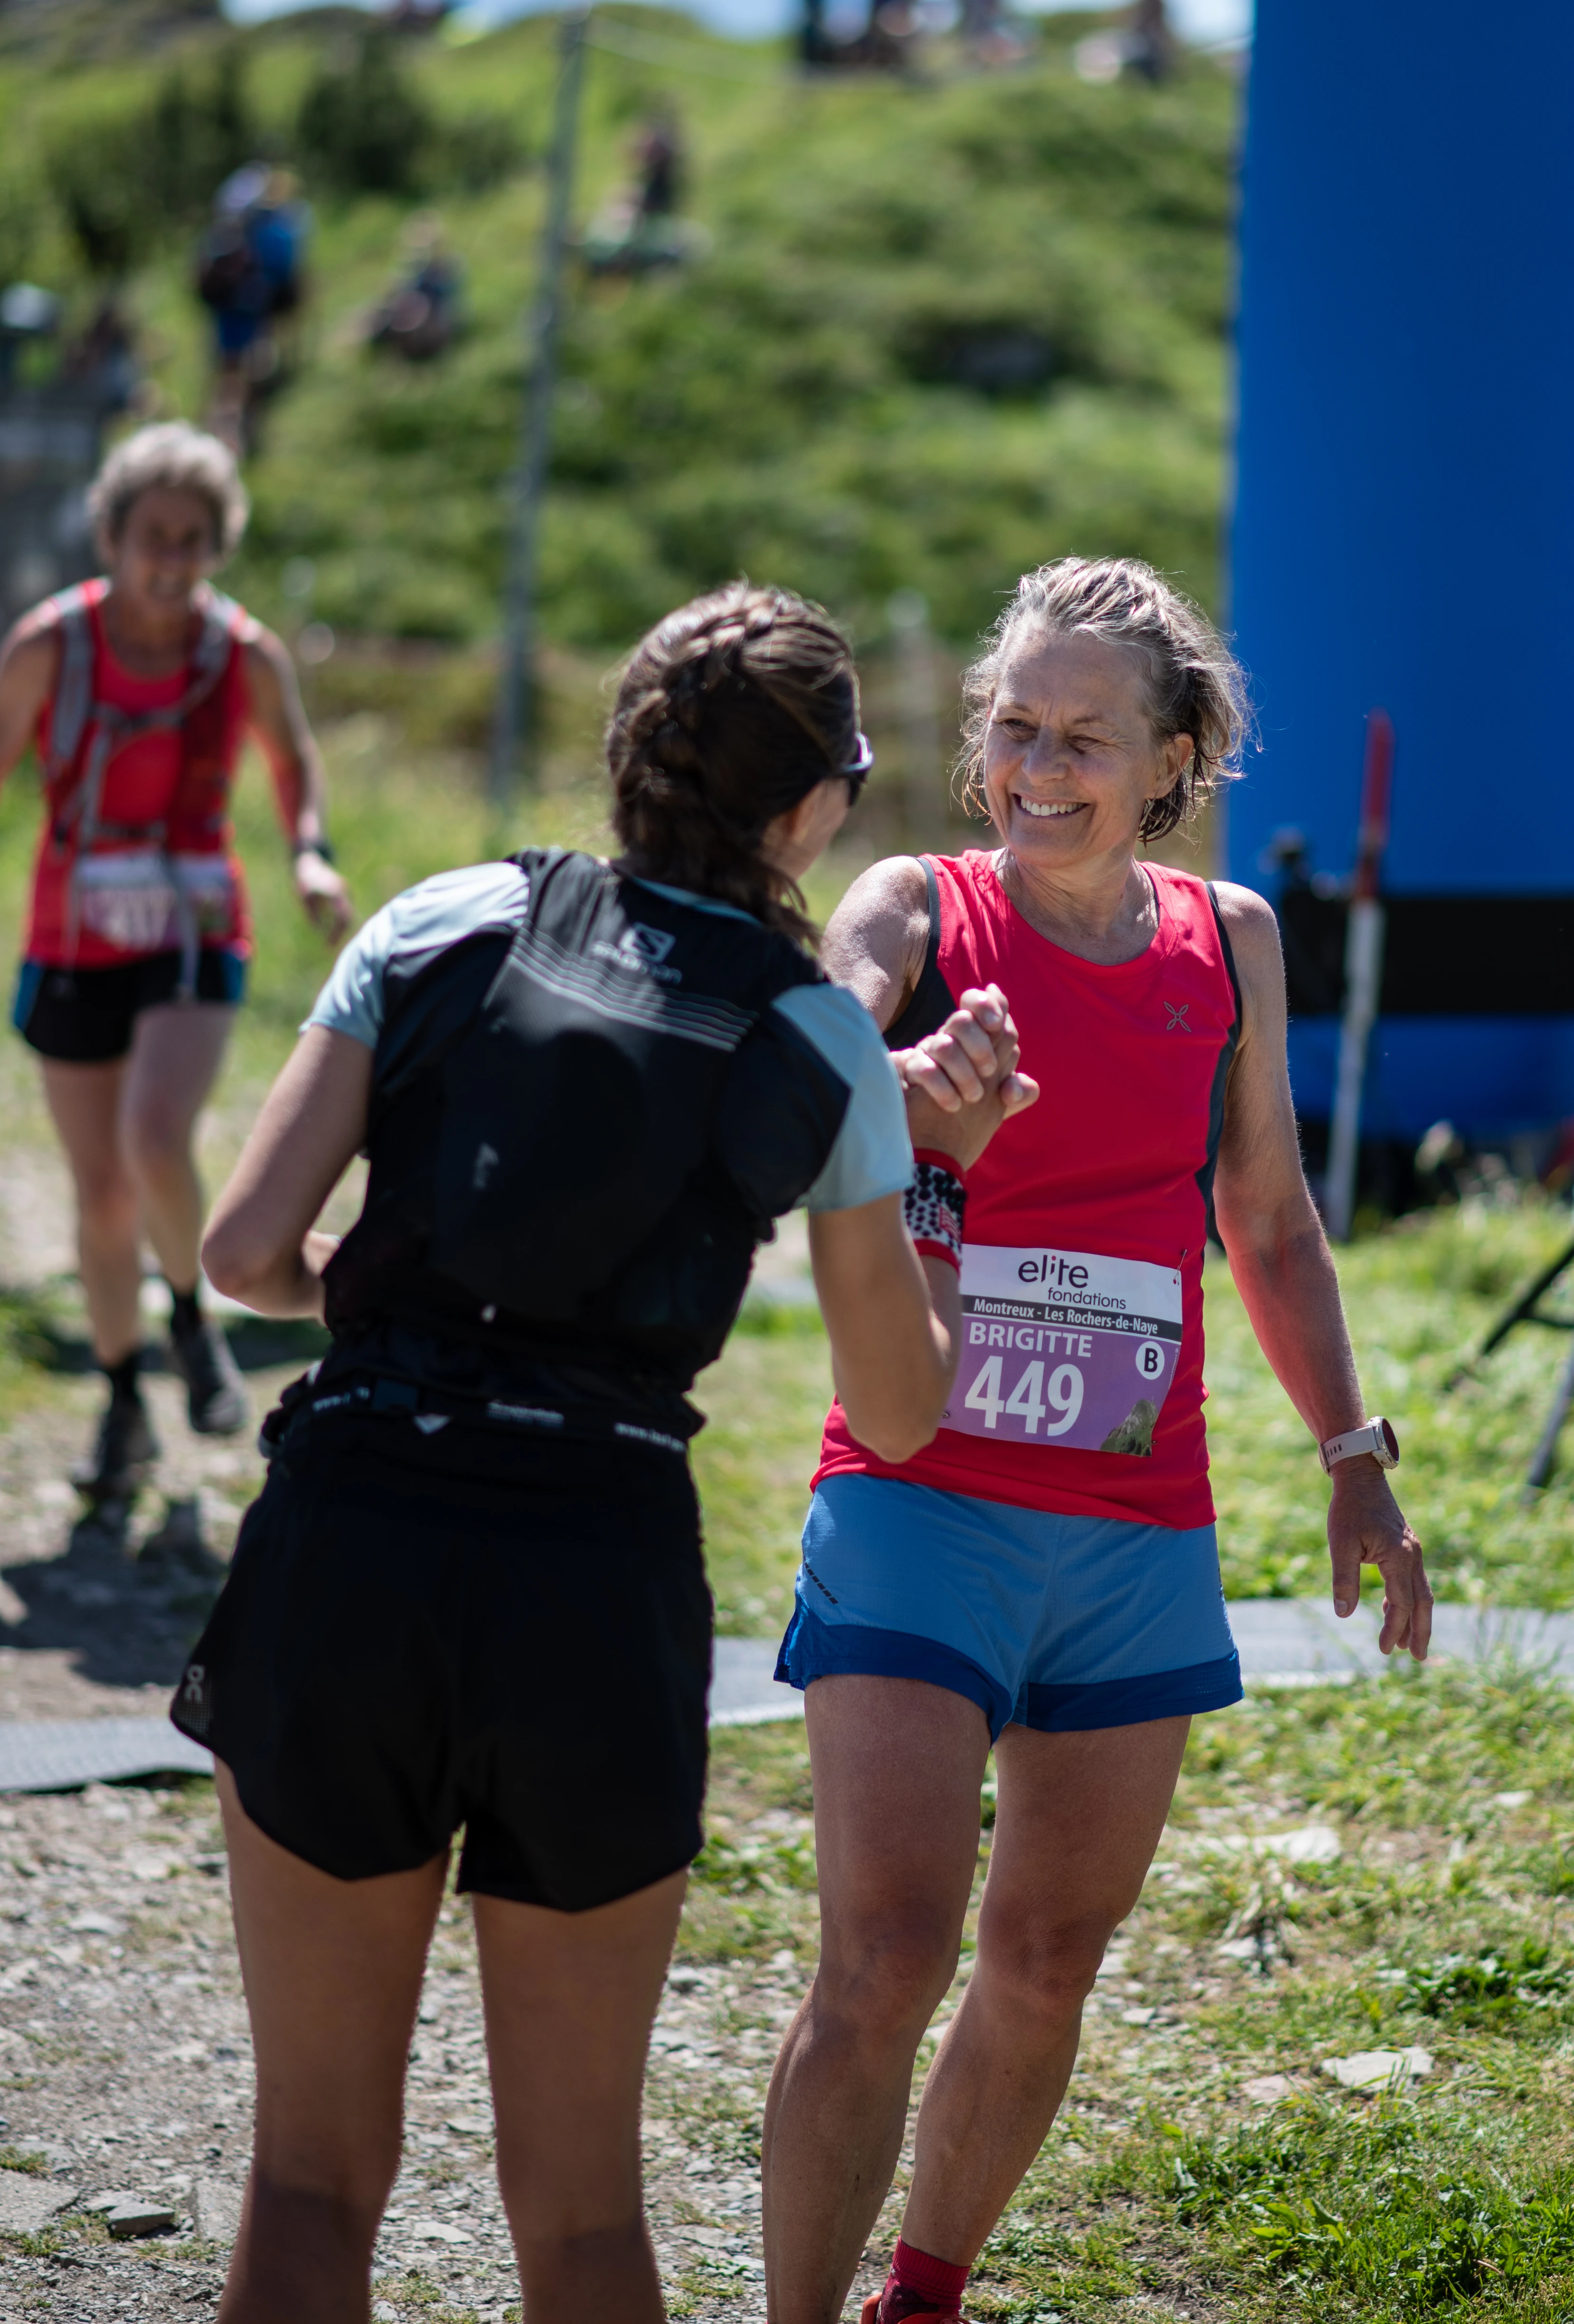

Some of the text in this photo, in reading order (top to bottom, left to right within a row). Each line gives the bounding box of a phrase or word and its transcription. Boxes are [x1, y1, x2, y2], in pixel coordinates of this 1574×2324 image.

[1018, 1254, 1089, 1289] elite
[1047, 1287, 1127, 1310] fondations
[973, 1298, 1035, 1318] Montreux
[1044, 1306, 1065, 1322] Les
[1066, 1309, 1158, 1336] Rochers-de-Naye
[969, 1321, 1093, 1358] BRIGITTE
[1143, 1347, 1159, 1373] B
[964, 1355, 1084, 1437] 449
